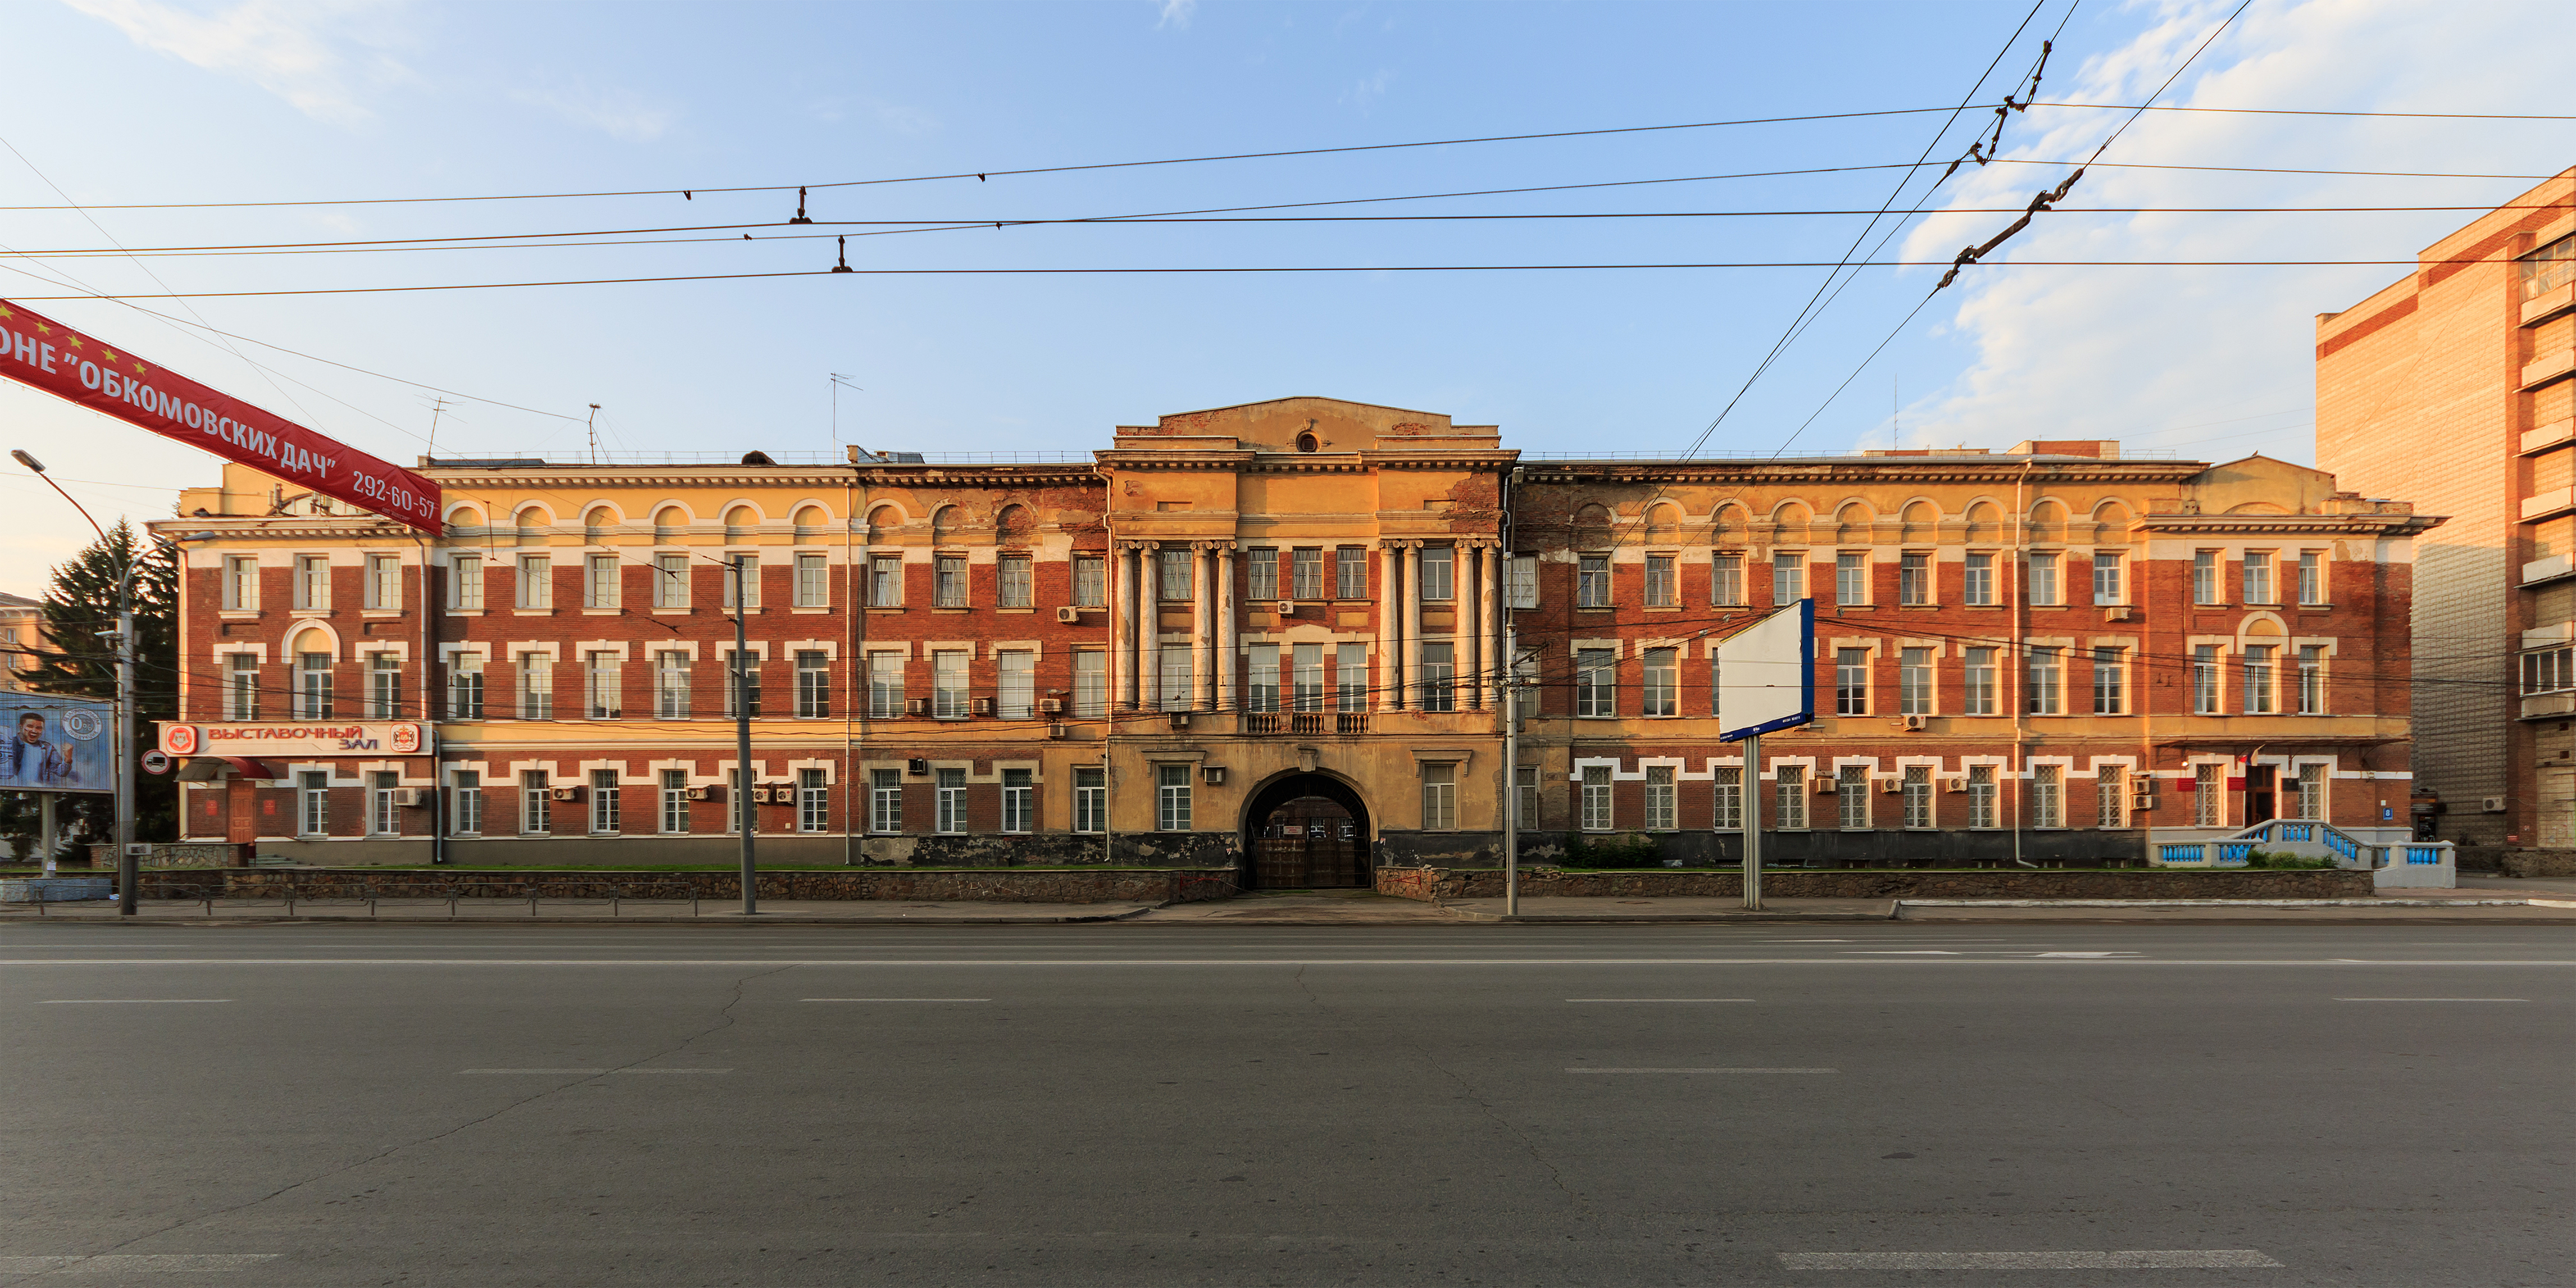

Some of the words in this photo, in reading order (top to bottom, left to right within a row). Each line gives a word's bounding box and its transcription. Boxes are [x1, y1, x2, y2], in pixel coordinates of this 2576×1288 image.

[63, 352, 277, 460] "ОБКОМОВСКИХ
[281, 441, 336, 478] ДАЧ"
[353, 471, 435, 519] 292-60-57
[71, 717, 92, 731] 0%
[208, 725, 362, 740] ВЫСТАВОЧНЫЙ
[338, 738, 377, 750] ЗАЛ
